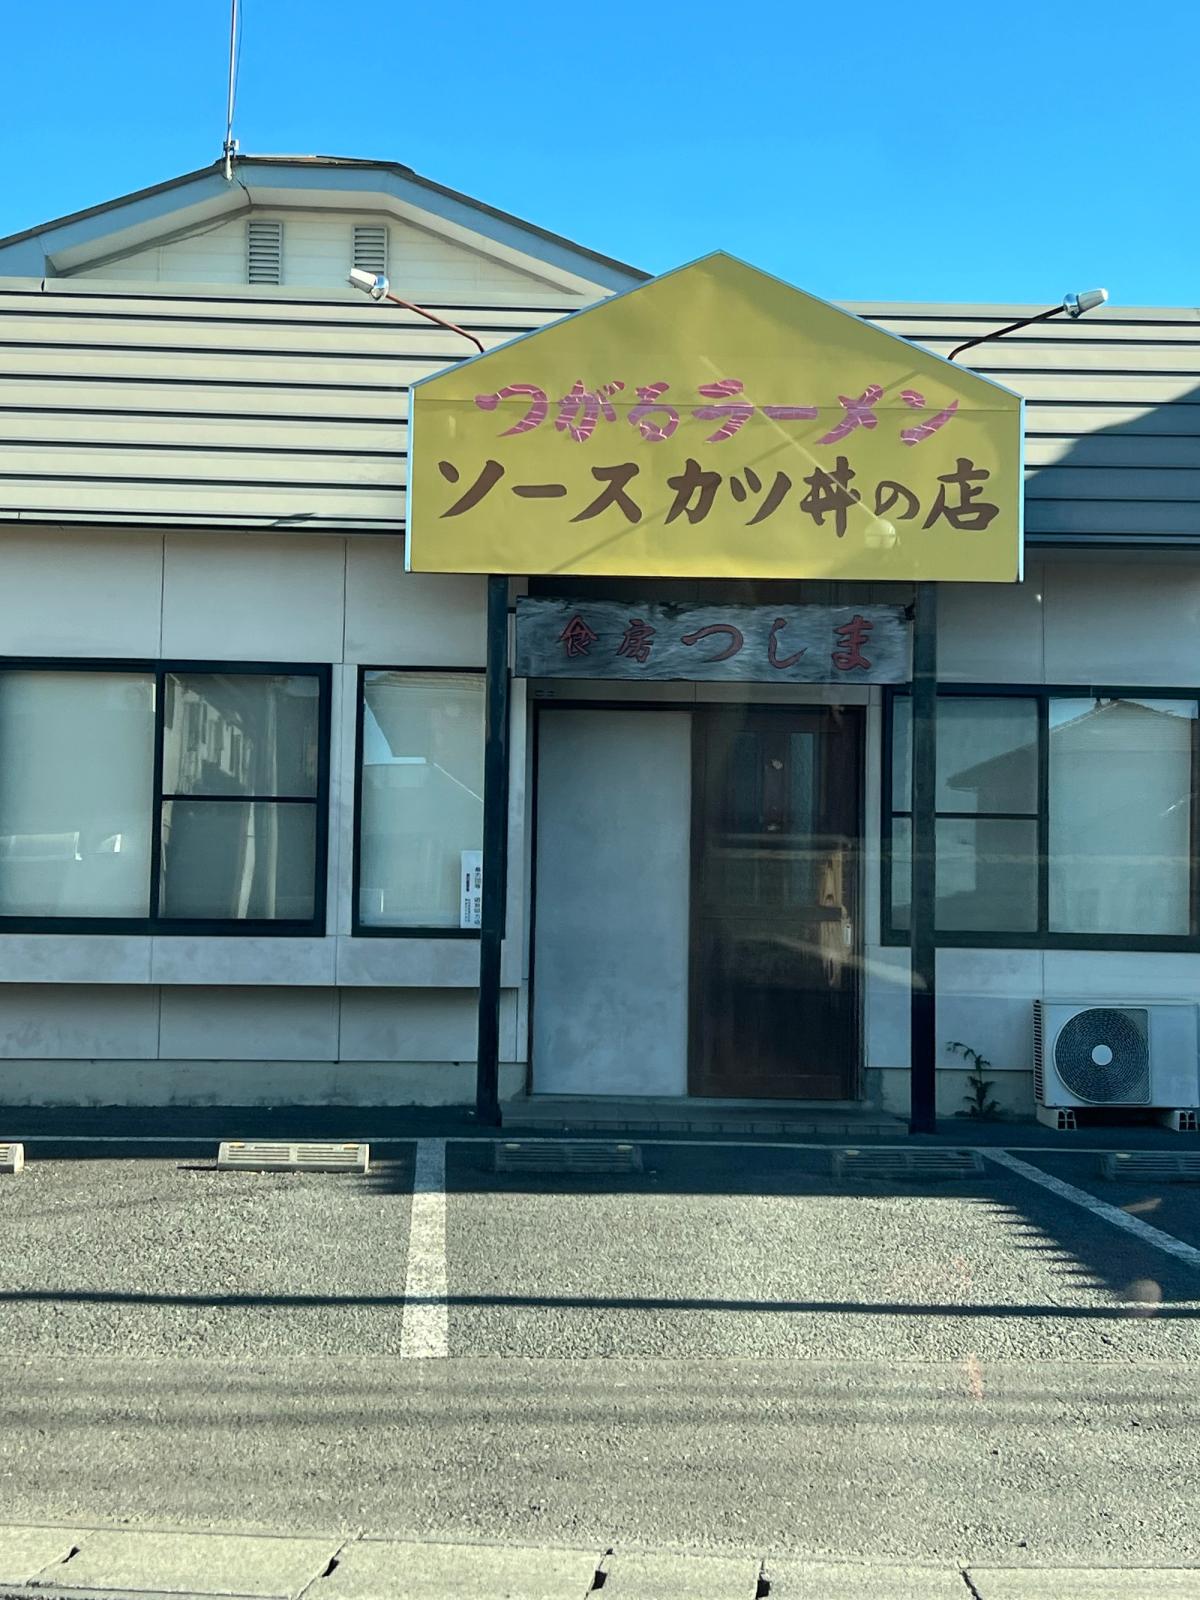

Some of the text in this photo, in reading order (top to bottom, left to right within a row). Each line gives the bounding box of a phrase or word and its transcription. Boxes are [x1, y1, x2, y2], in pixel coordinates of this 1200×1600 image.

[474, 379, 960, 447] つがるラーメン
[437, 456, 1000, 538] ソースカツ丼の店
[559, 614, 875, 670] 食房つしま
